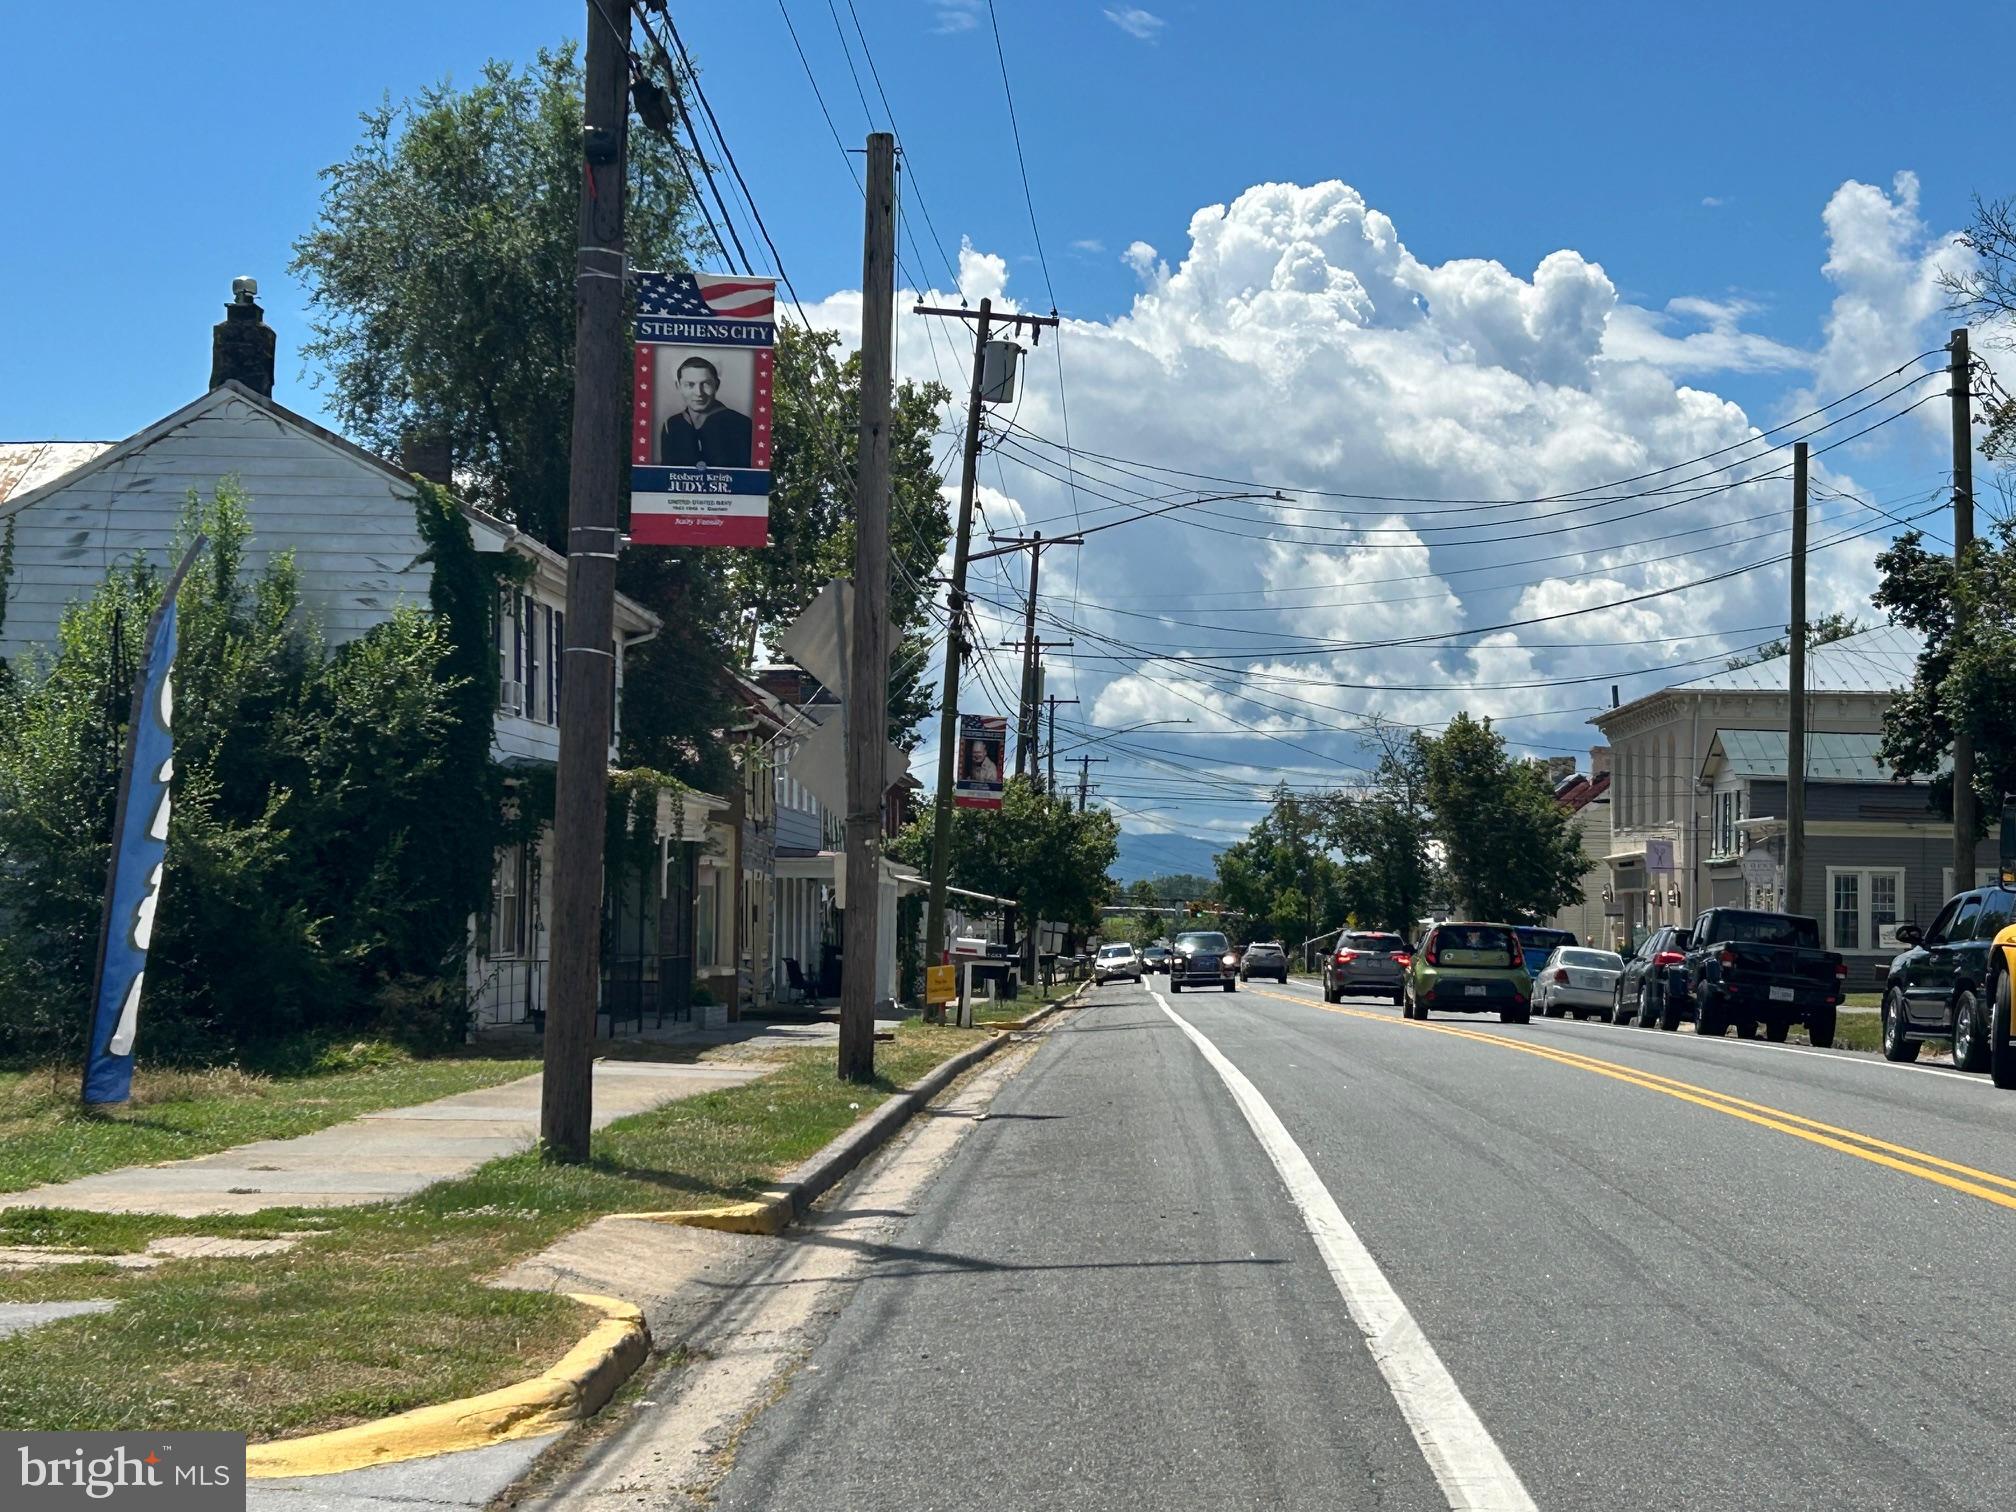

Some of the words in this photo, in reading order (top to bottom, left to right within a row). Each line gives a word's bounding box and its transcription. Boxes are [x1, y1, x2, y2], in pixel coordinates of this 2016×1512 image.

[641, 321, 729, 338] STEPHENS
[730, 325, 769, 340] CITY
[669, 472, 704, 480] Robert
[709, 482, 732, 493] SR.
